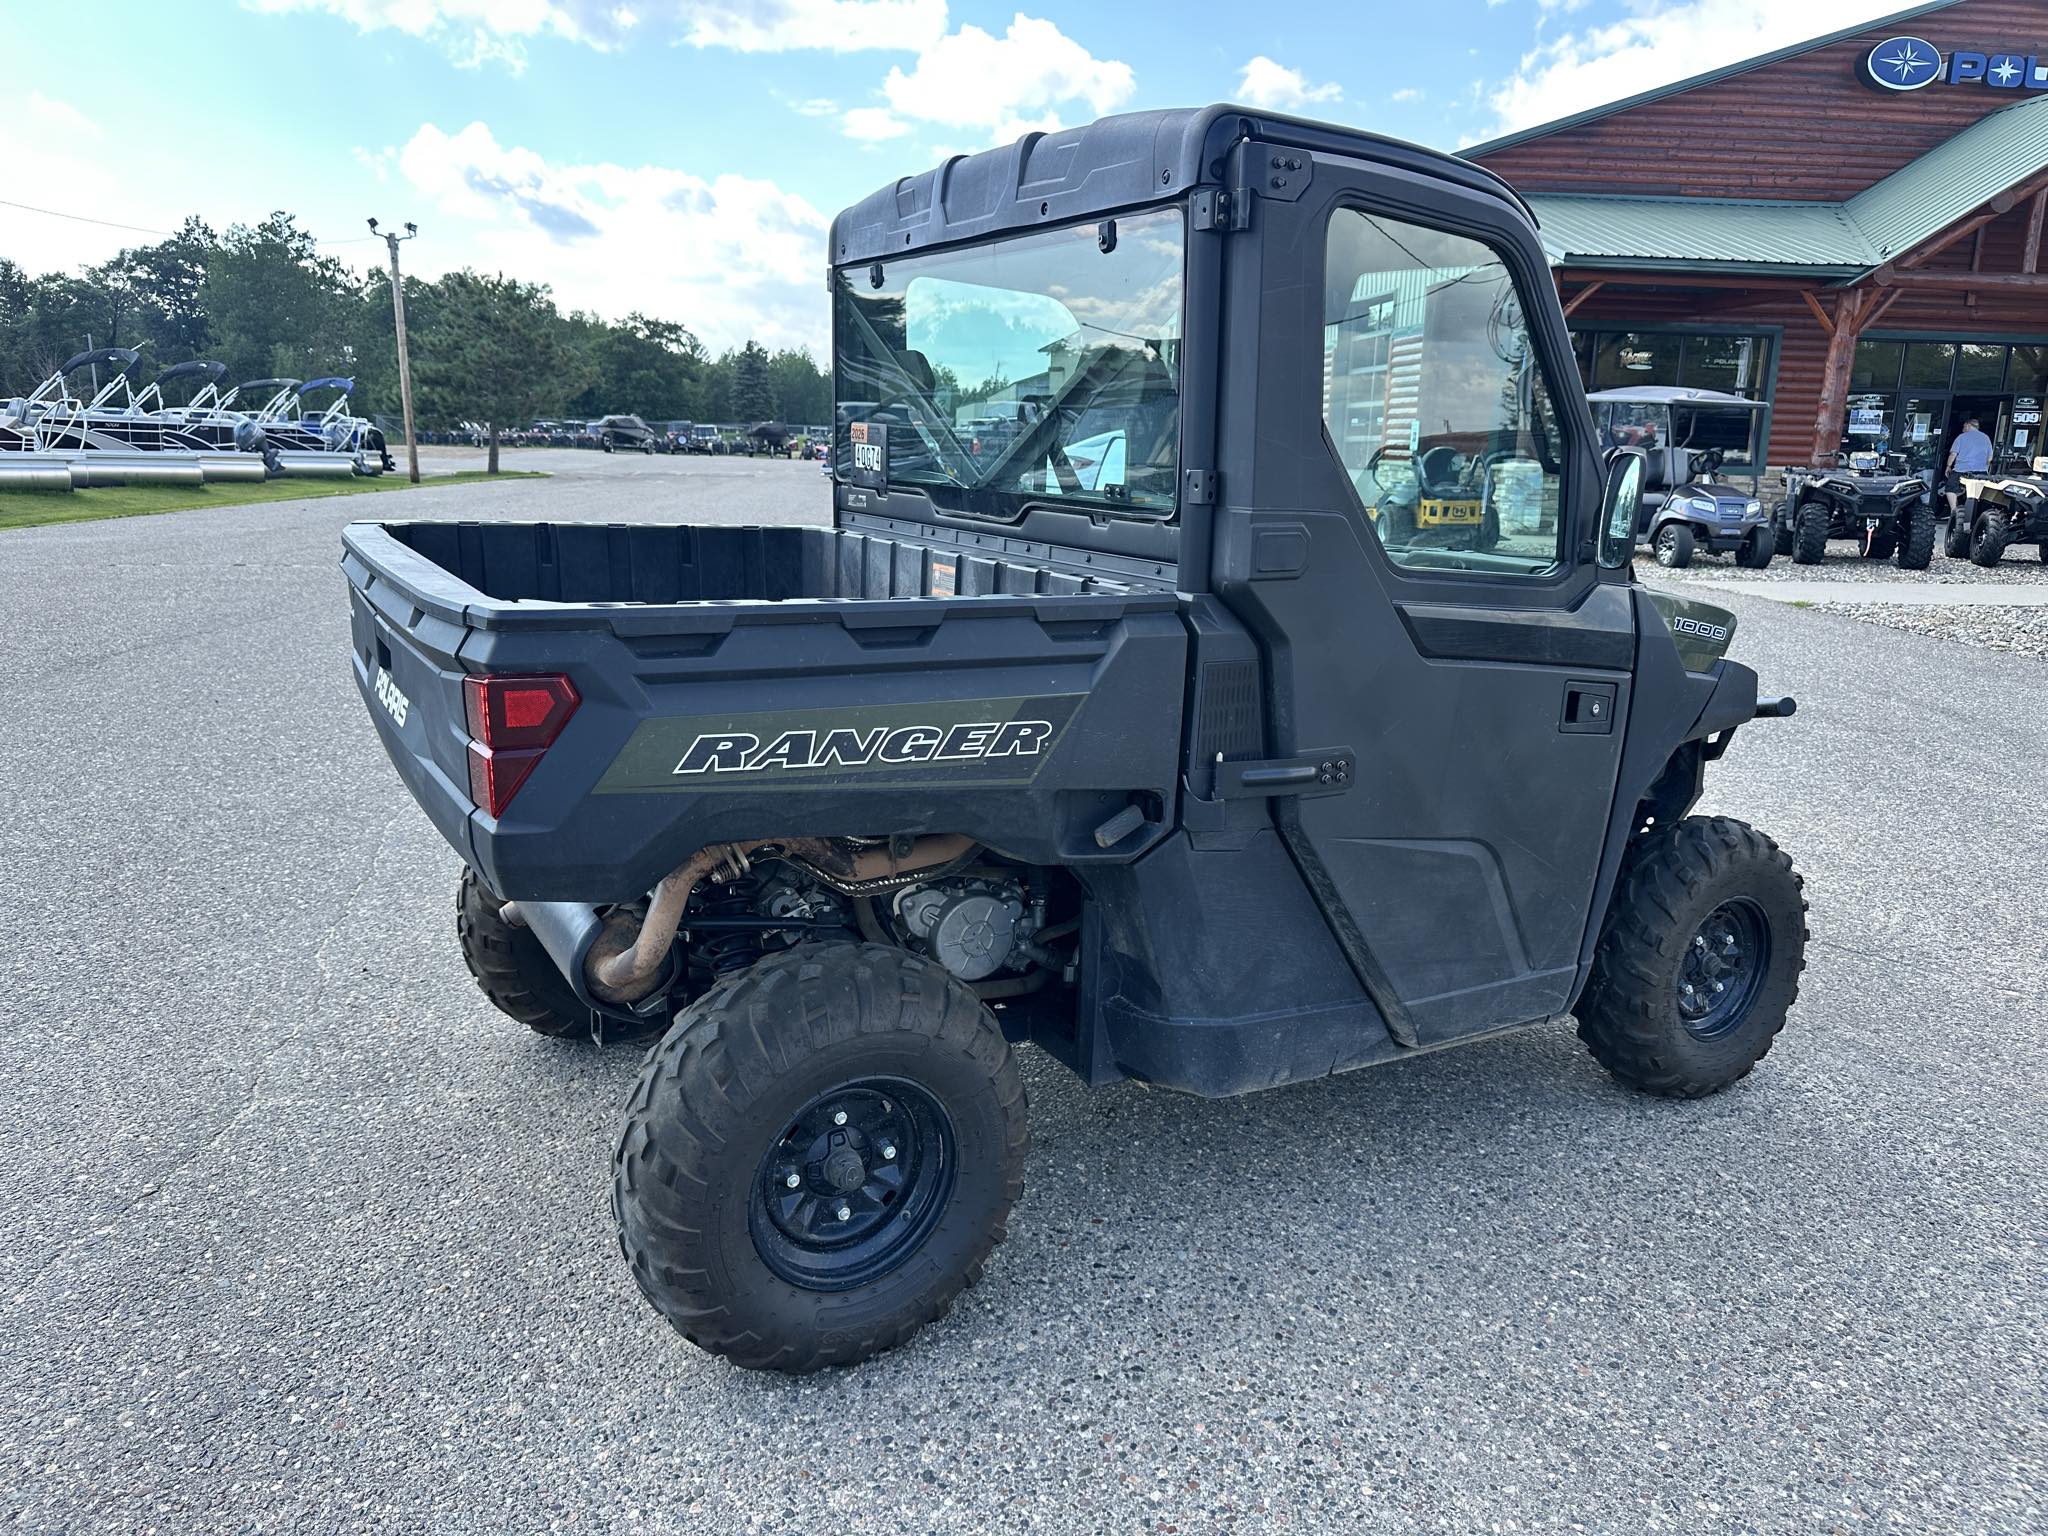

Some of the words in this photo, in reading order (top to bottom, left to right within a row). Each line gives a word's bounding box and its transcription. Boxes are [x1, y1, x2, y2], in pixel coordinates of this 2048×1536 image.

[2013, 412, 2039, 423] 509
[851, 428, 865, 440] 2026
[1673, 616, 1727, 641] 1000
[374, 666, 410, 728] POLARIS
[672, 720, 1053, 774] RANGER
